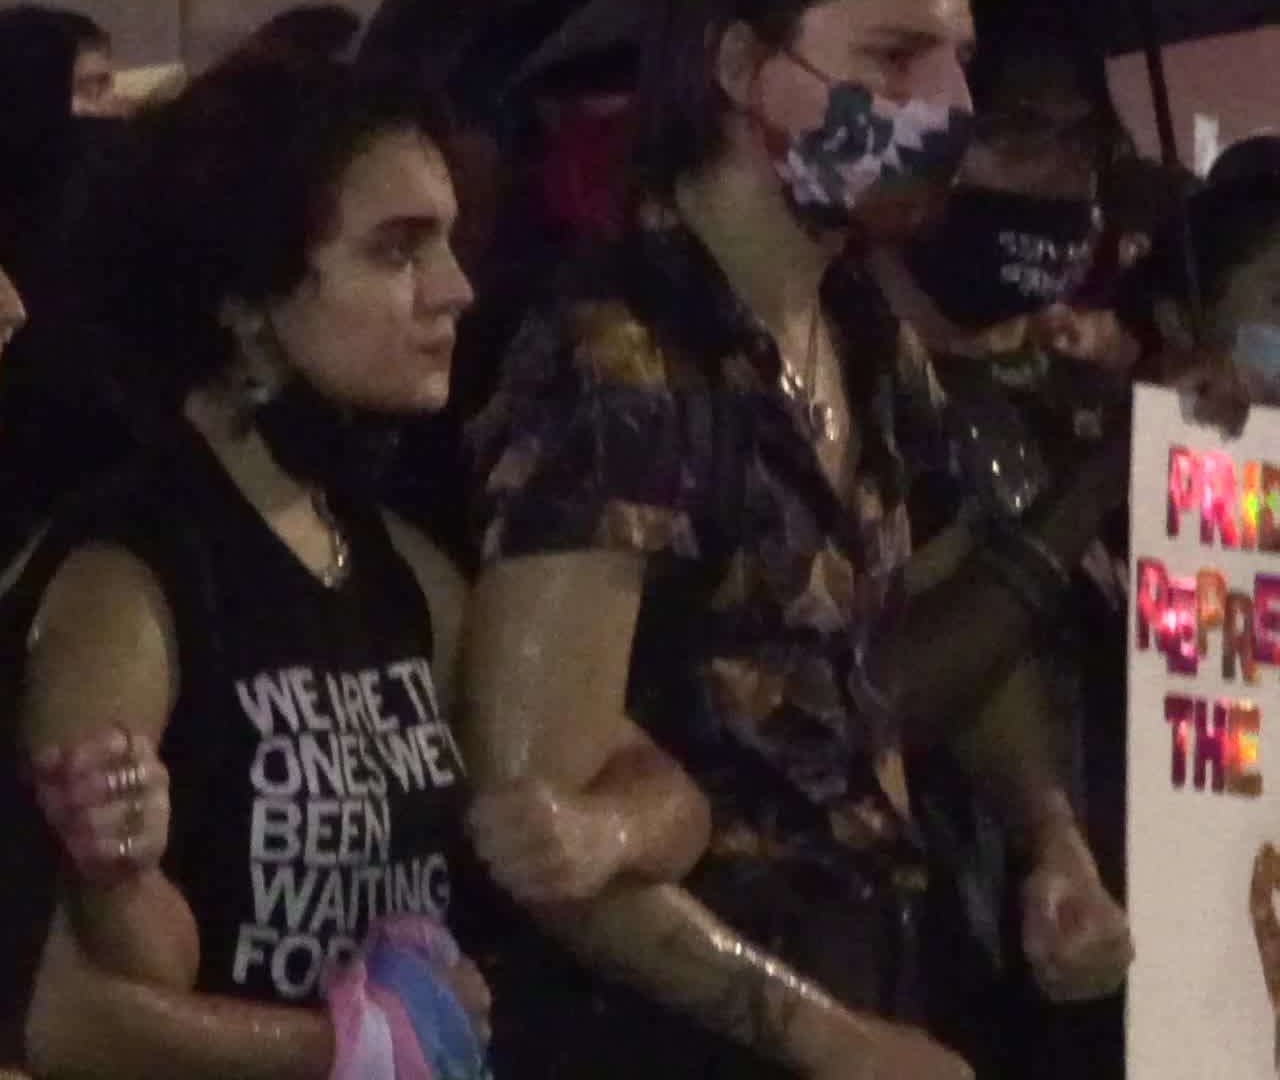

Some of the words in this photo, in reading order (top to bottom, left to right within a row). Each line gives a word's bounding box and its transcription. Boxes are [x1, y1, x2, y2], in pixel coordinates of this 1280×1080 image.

[235, 666, 332, 735] WE
[250, 731, 388, 798] ONES
[1164, 690, 1264, 799] THE
[250, 796, 391, 865] BEEN
[251, 853, 451, 932] WAITING
